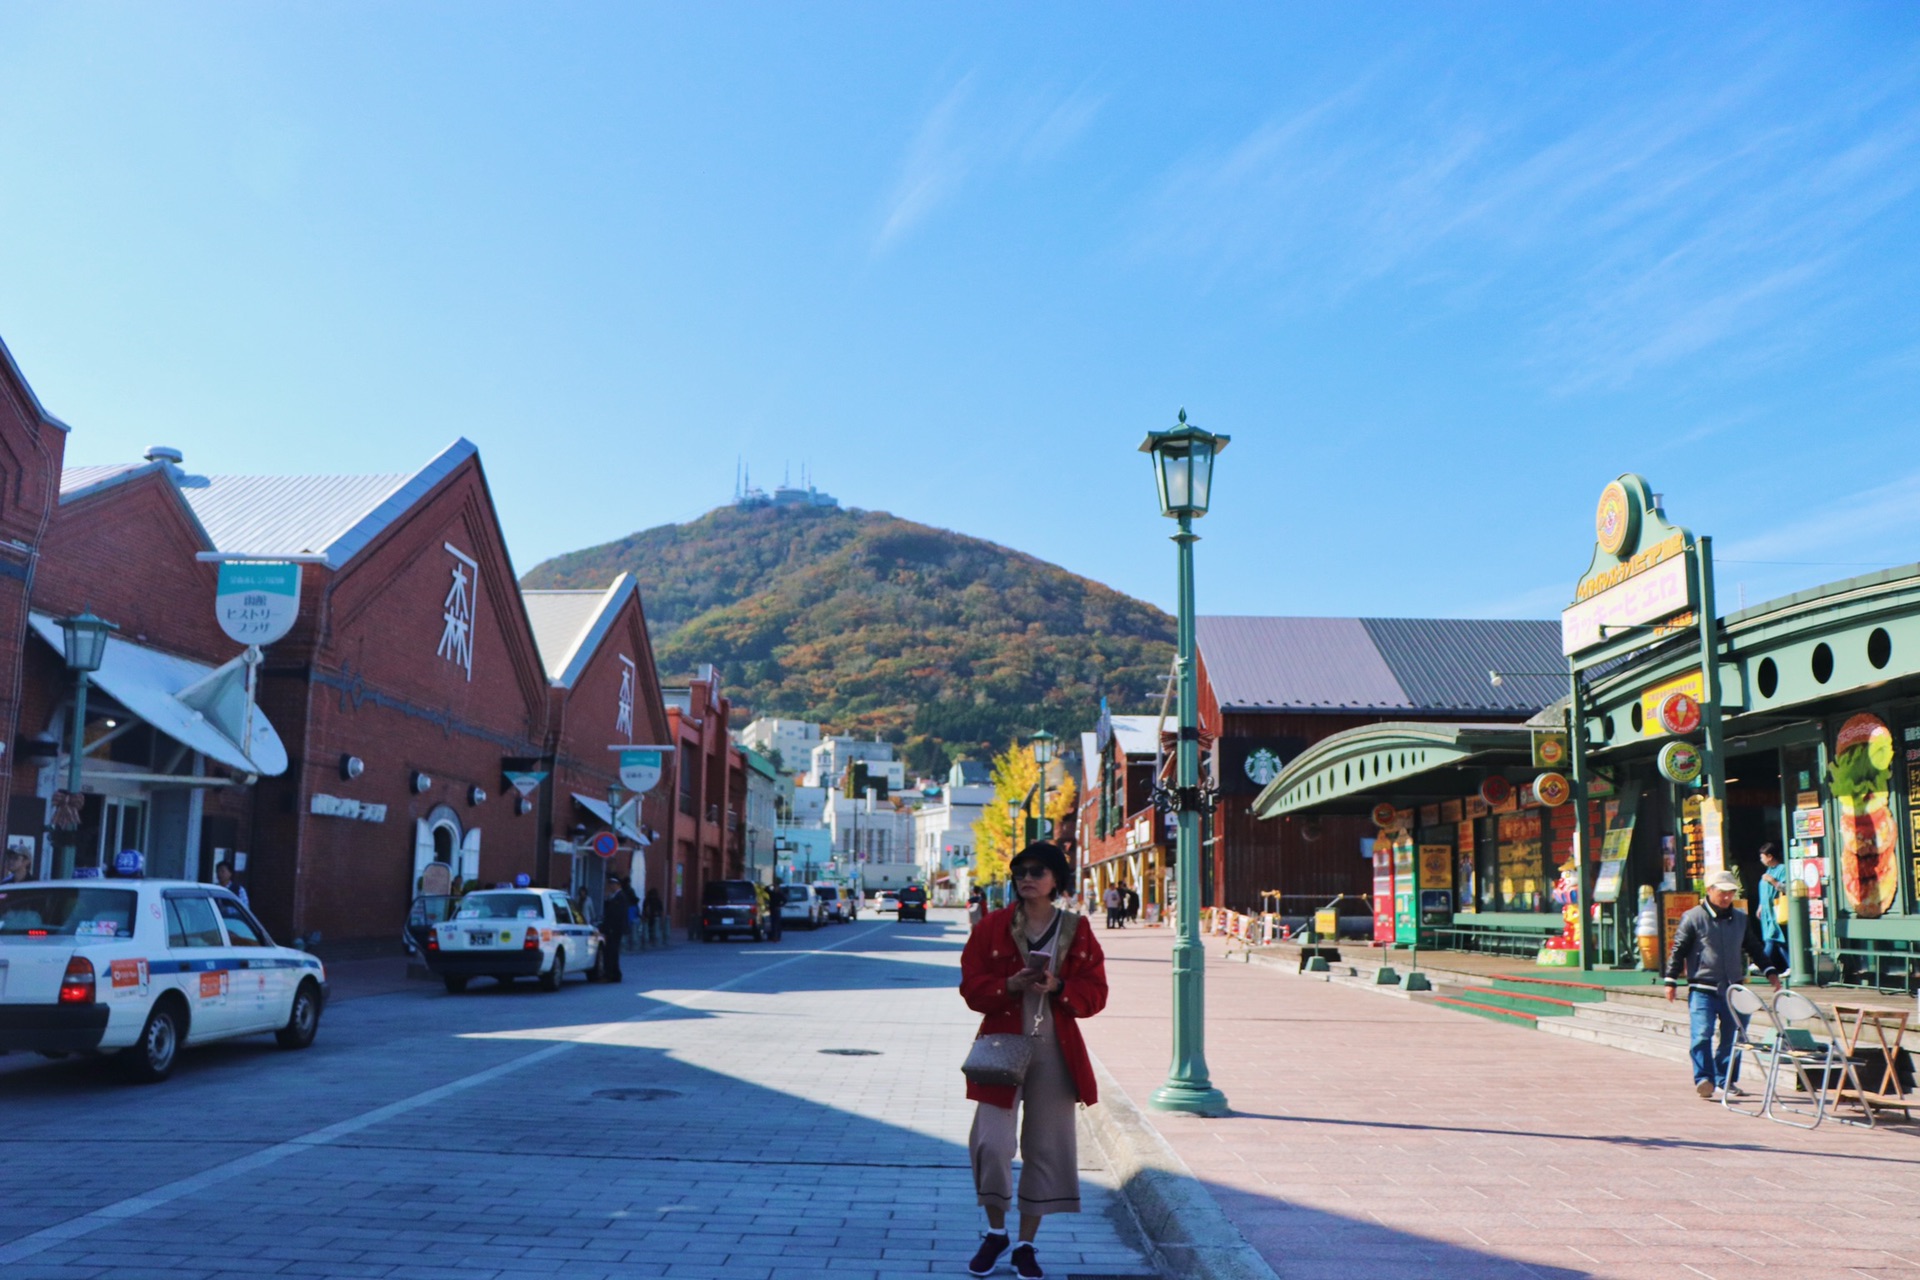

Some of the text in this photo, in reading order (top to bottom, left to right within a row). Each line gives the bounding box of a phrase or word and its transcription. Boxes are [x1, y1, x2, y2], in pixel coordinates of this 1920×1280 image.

[226, 608, 284, 620] ヒストリー
[1567, 571, 1679, 641] ラッキーピエロ
